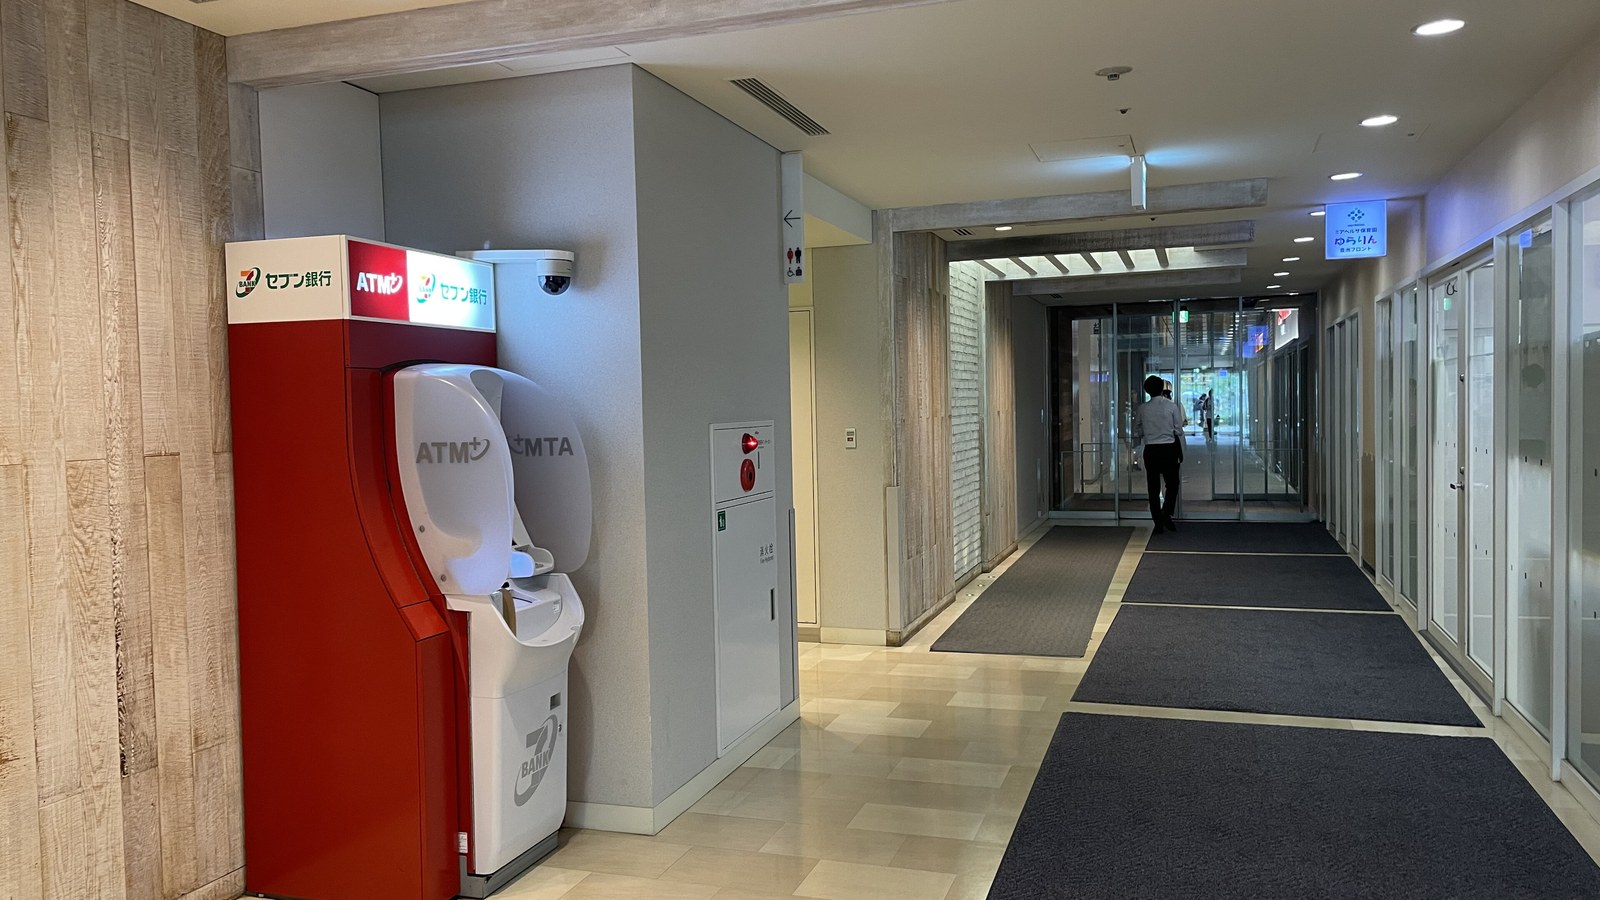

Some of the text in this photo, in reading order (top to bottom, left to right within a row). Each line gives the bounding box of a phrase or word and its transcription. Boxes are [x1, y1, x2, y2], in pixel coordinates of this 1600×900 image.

[1334, 235, 1378, 246] ゆらりん
[238, 280, 256, 288] BANK
[265, 270, 332, 290] セブン銀行
[440, 282, 487, 305] セブン銀行
[521, 748, 550, 779] BANK
